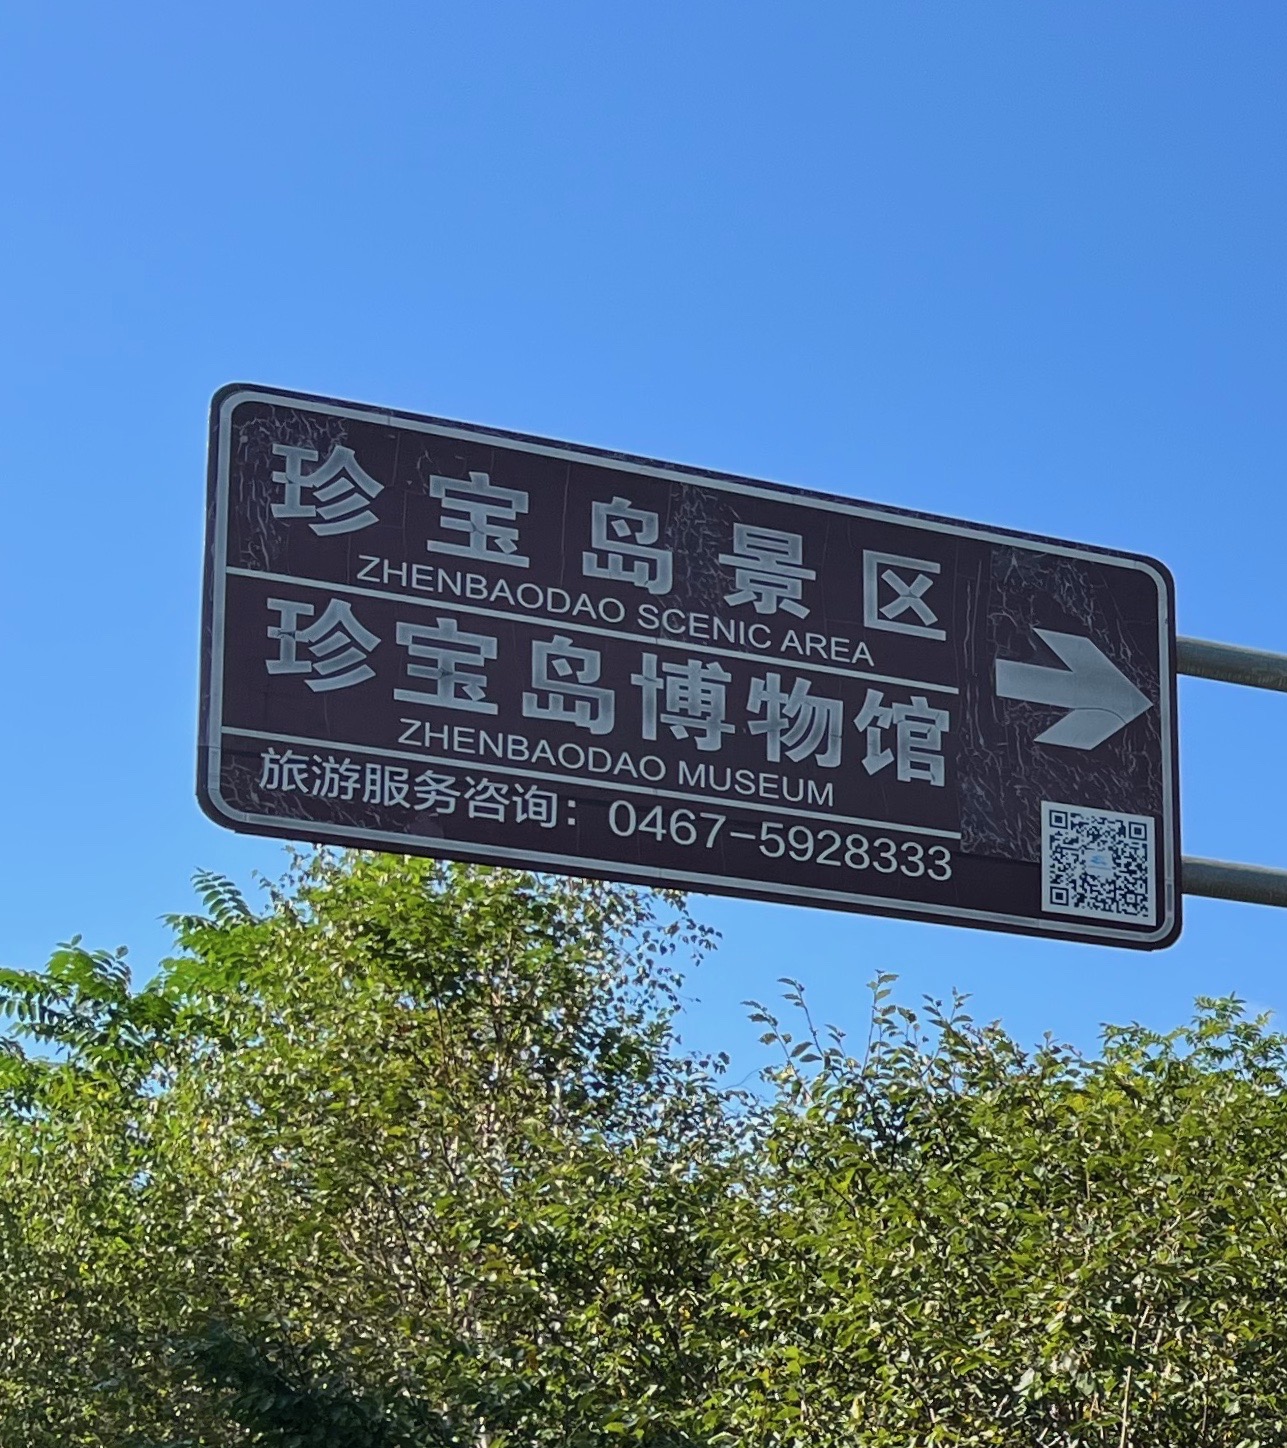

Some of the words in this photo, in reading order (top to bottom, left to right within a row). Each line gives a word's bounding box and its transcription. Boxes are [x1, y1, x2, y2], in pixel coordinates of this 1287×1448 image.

[271, 443, 946, 641] 珍宝岛景区
[356, 555, 626, 623] ZHENBAODAO
[637, 605, 772, 650] SCENIC
[780, 629, 875, 667] AREA
[265, 597, 950, 787] 珍宝岛博物馆
[397, 719, 667, 780] ZHENBAODAO
[678, 760, 834, 807] MUSEUM
